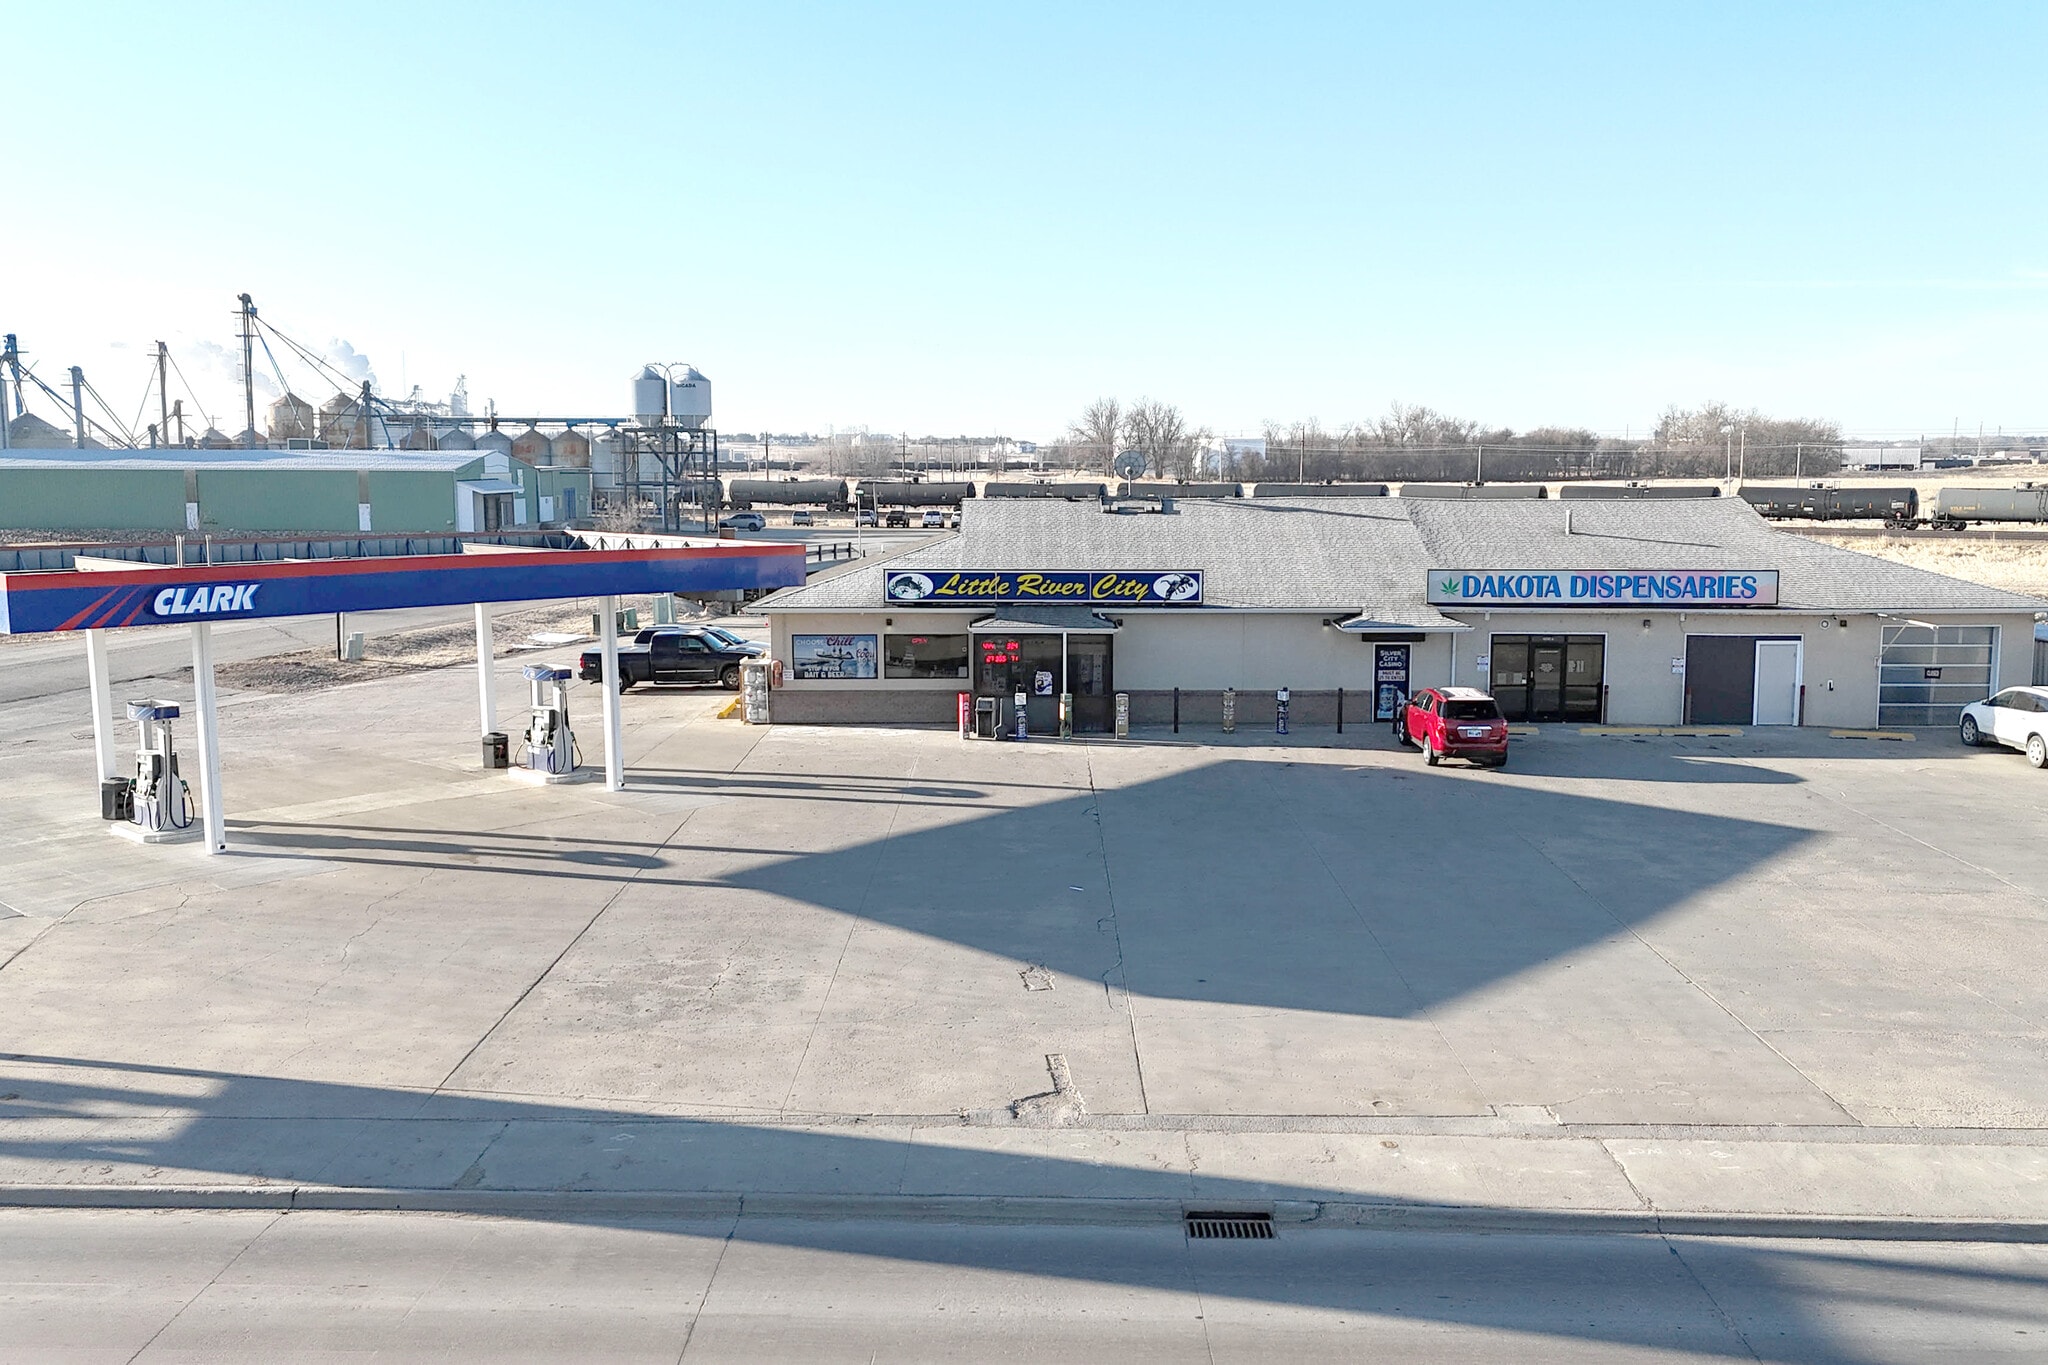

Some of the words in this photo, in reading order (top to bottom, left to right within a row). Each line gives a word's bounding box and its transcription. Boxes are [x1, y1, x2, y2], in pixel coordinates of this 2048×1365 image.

[153, 584, 261, 616] CLARK
[934, 573, 1010, 596] Little
[1016, 573, 1086, 597] River
[1091, 572, 1150, 601] City
[1461, 575, 1562, 599] DAKOTA
[1569, 575, 1758, 600] DISPENSARIES
[825, 635, 856, 647] Chill
